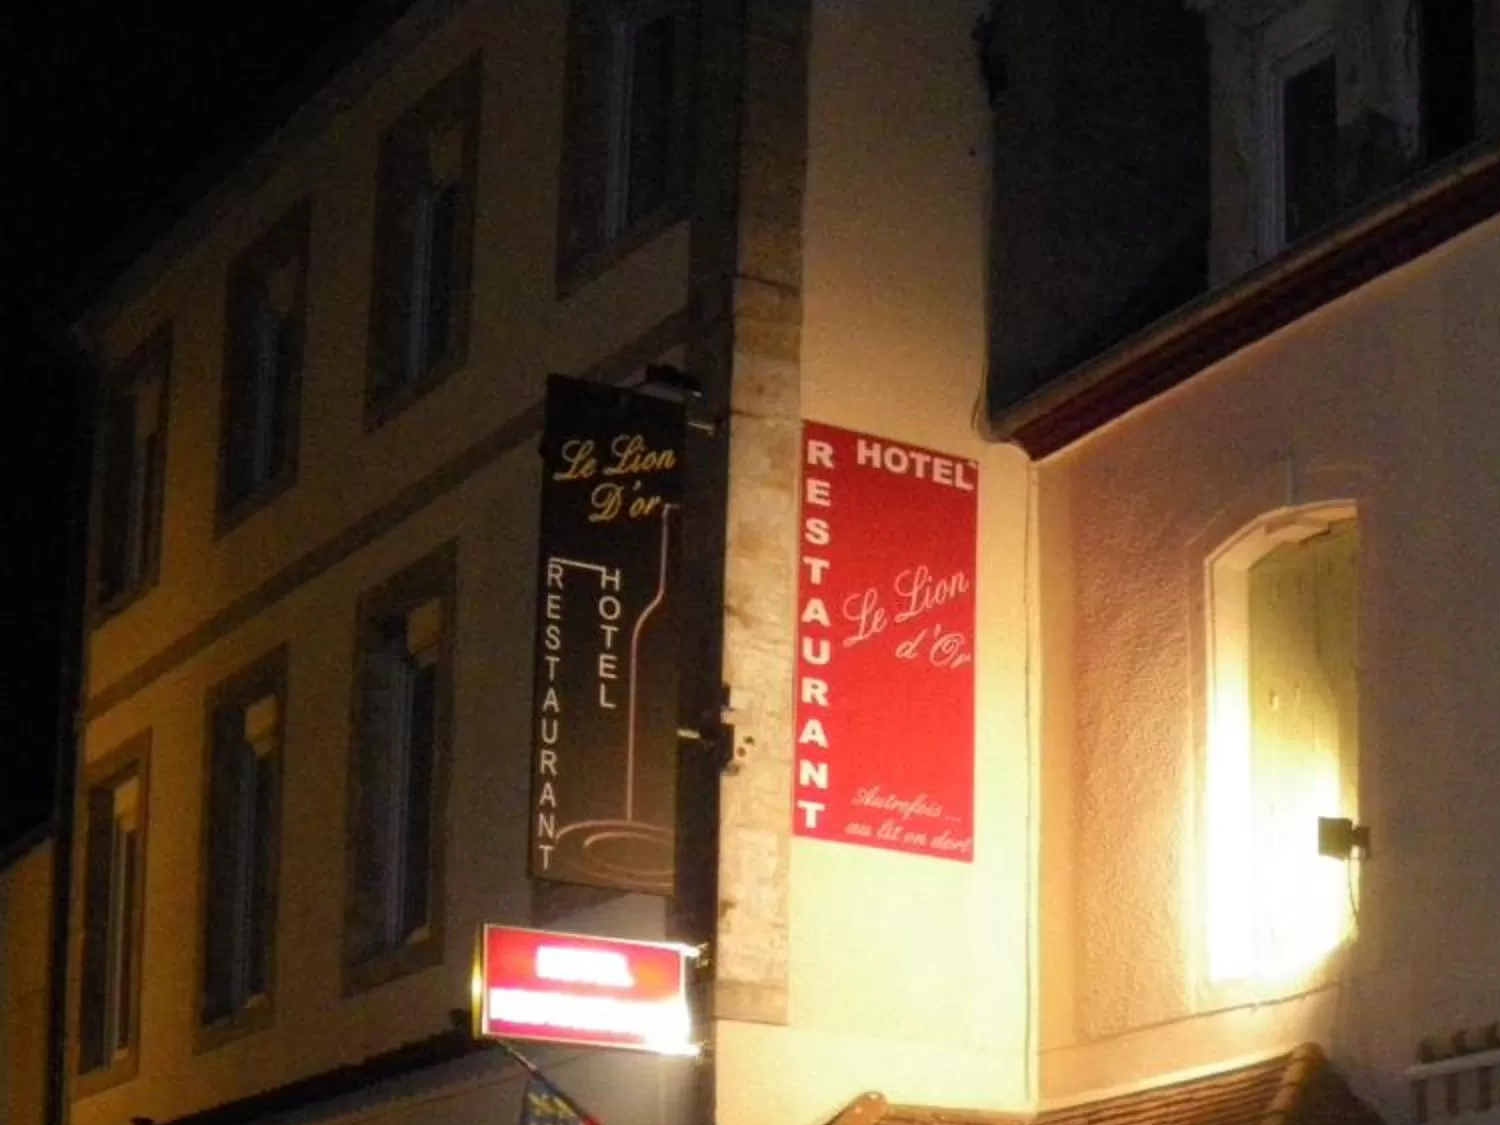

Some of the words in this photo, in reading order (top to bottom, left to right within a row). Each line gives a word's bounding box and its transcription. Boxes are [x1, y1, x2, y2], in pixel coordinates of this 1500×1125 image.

[552, 439, 598, 481] Le
[602, 434, 680, 476] Lion
[856, 438, 974, 491] HOTEL
[587, 480, 662, 523] D'or
[598, 567, 622, 710] HOTEL
[798, 438, 835, 829] RESTAURANT
[843, 587, 888, 648] Le
[894, 564, 970, 624] Lion
[537, 562, 563, 871] RESTAURANT
